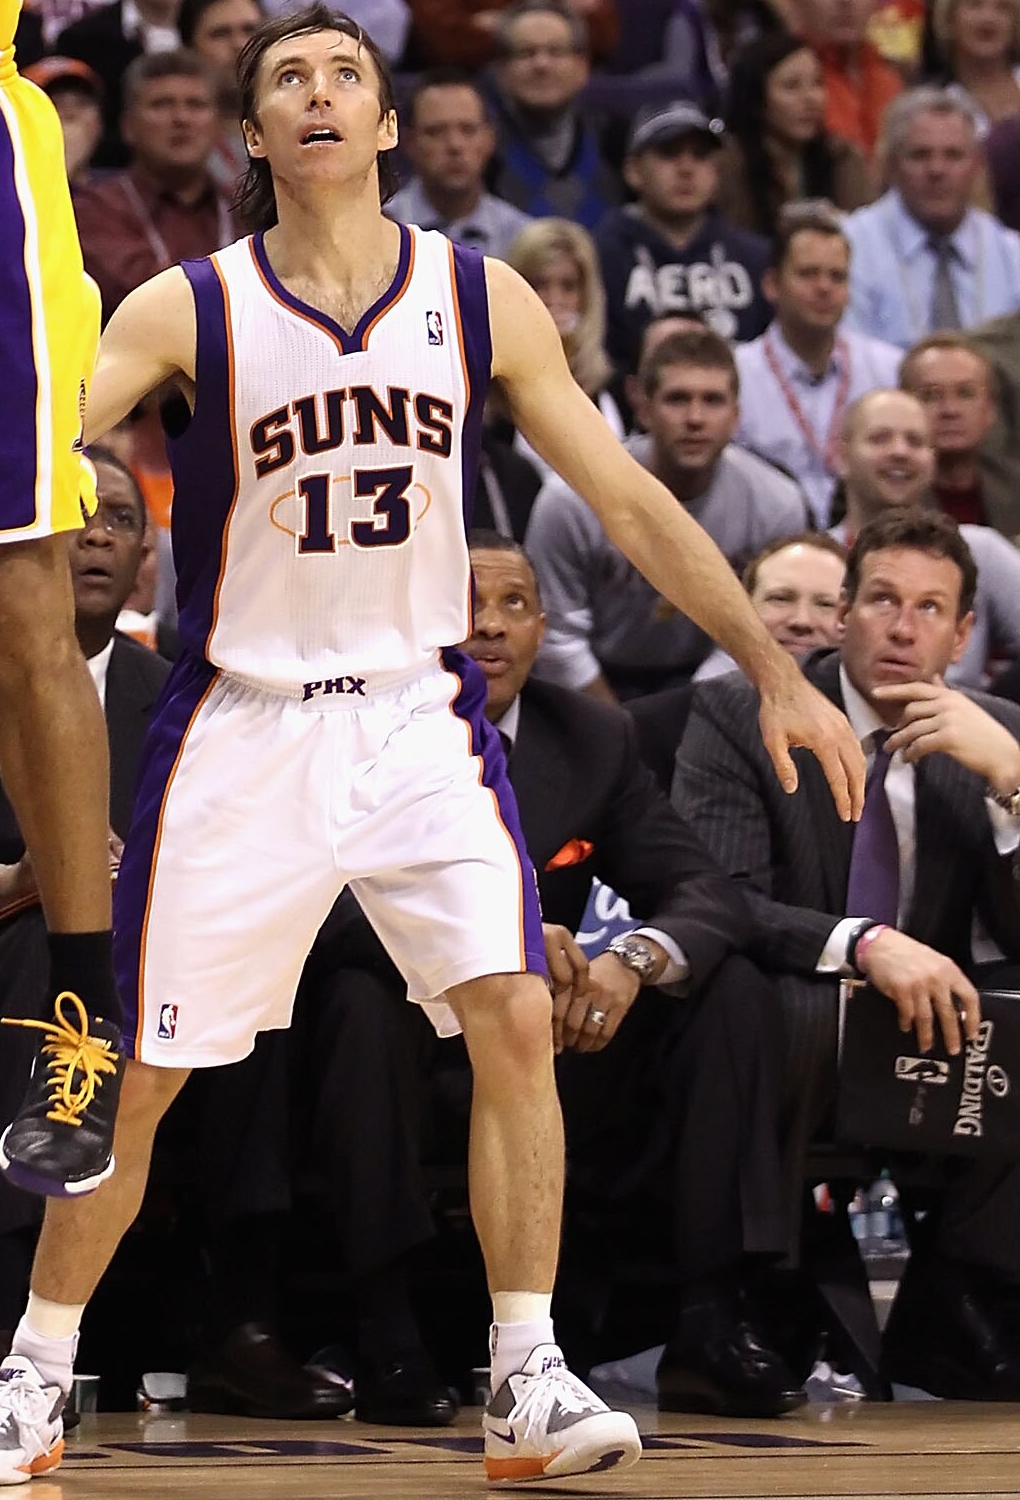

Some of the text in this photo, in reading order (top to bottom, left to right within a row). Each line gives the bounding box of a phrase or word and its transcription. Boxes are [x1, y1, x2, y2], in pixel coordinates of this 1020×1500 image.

[625, 261, 753, 313] AERO
[250, 385, 454, 480] SUNS
[295, 464, 415, 557] 13
[301, 675, 367, 702] PHX
